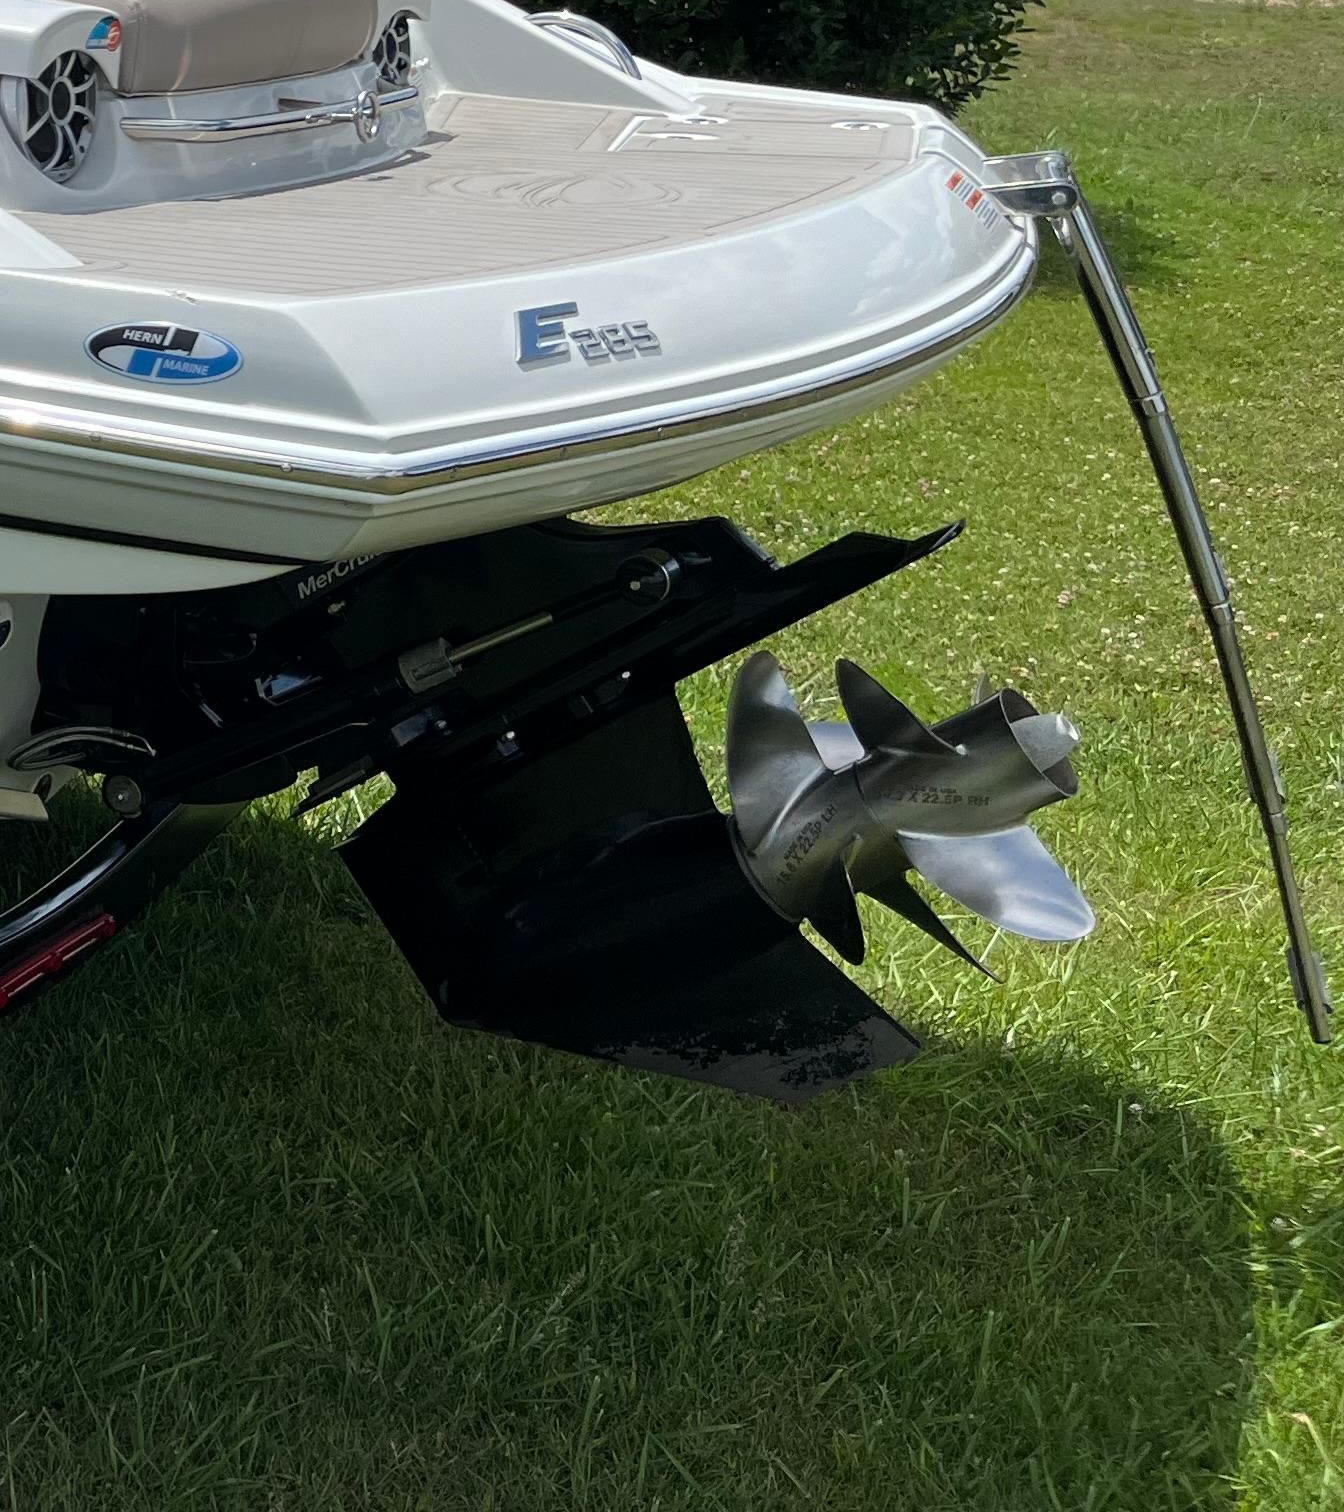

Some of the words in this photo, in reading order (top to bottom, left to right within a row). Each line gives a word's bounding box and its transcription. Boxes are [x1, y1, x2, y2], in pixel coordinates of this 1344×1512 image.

[122, 328, 165, 346] HERN
[161, 357, 211, 377] MARINE
[968, 795, 991, 807] RH
[821, 804, 838, 824] LH
